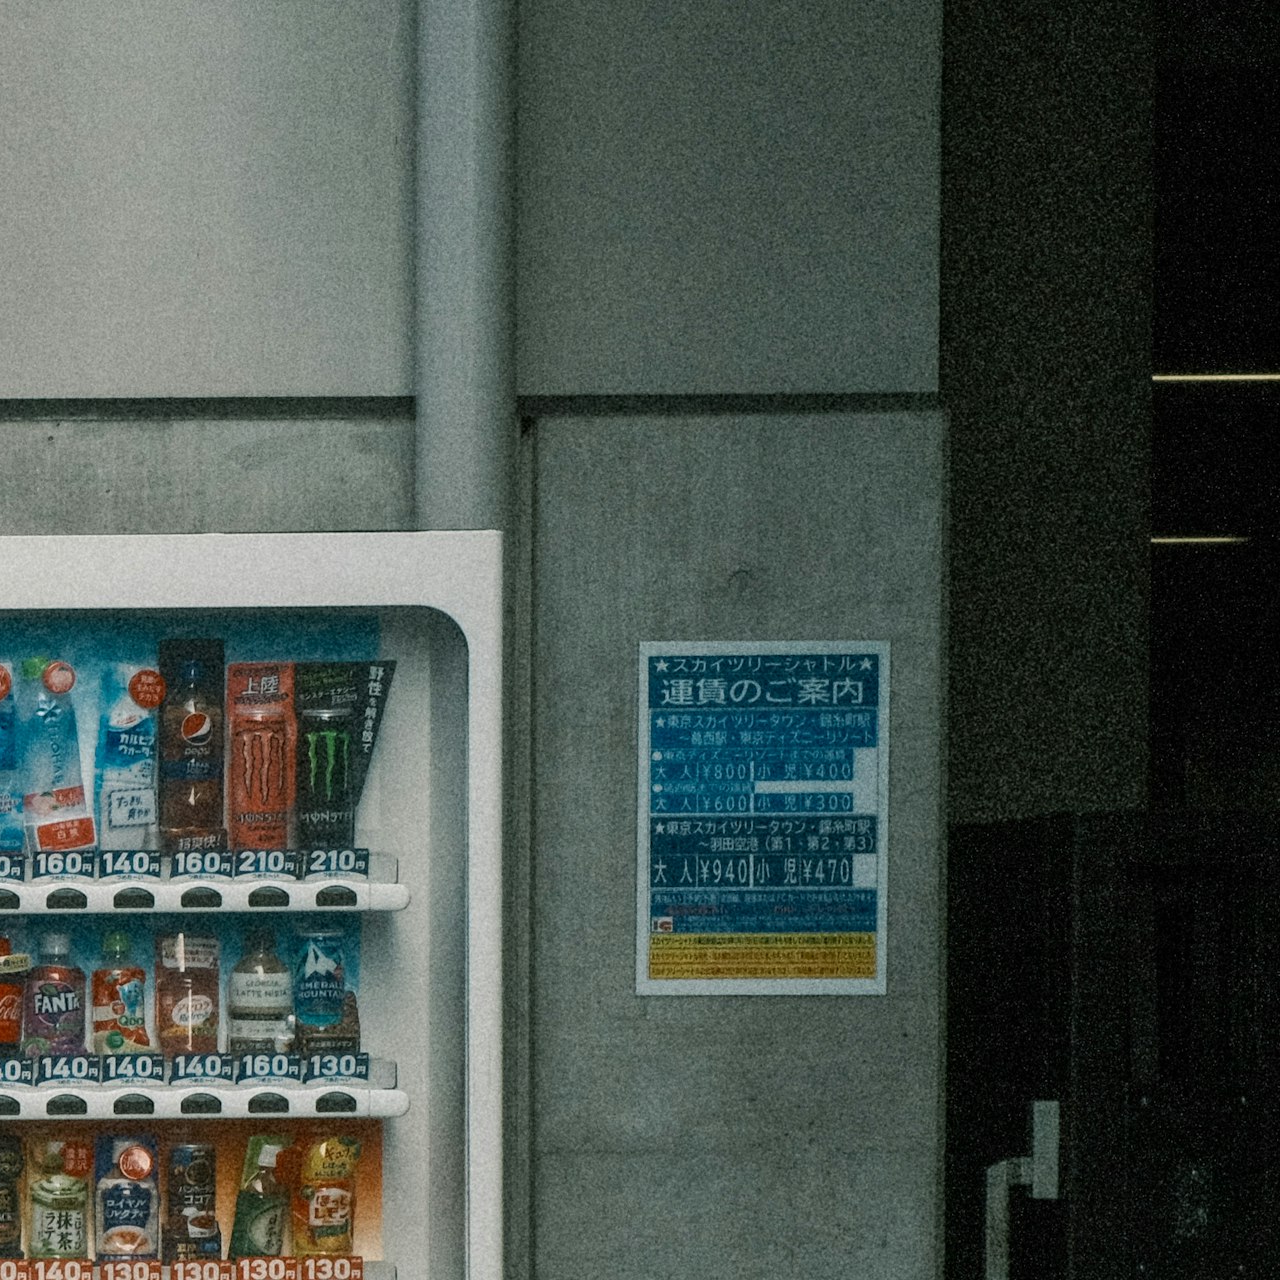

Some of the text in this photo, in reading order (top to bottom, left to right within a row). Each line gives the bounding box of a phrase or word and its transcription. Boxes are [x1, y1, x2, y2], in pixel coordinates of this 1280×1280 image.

[673, 657, 857, 673] スカイツリーシャトル
[242, 675, 280, 696] 上陸
[661, 678, 865, 706] 運賃のご案内
[702, 764, 748, 781] ¥800
[804, 764, 852, 781] ¥400
[702, 796, 852, 813] ¥600 ¥300
[33, 854, 91, 873] 160円
[103, 853, 159, 873] 140円
[175, 853, 231, 874] 160円
[240, 852, 294, 872] 210円
[310, 850, 365, 871] 210円
[699, 857, 749, 884] ¥940
[802, 857, 851, 884] ¥470
[42, 1057, 98, 1078] 140円
[107, 1056, 163, 1077] 140円
[175, 1056, 231, 1077] 140円
[243, 1055, 299, 1076] 160円
[311, 1055, 366, 1075] 130円
[106, 1199, 146, 1209] ロイヤル
[45, 1212, 56, 1242] ラテ
[56, 1211, 73, 1251] 抹茶
[240, 1259, 295, 1280] 130円
[305, 1258, 360, 1280] 130円
